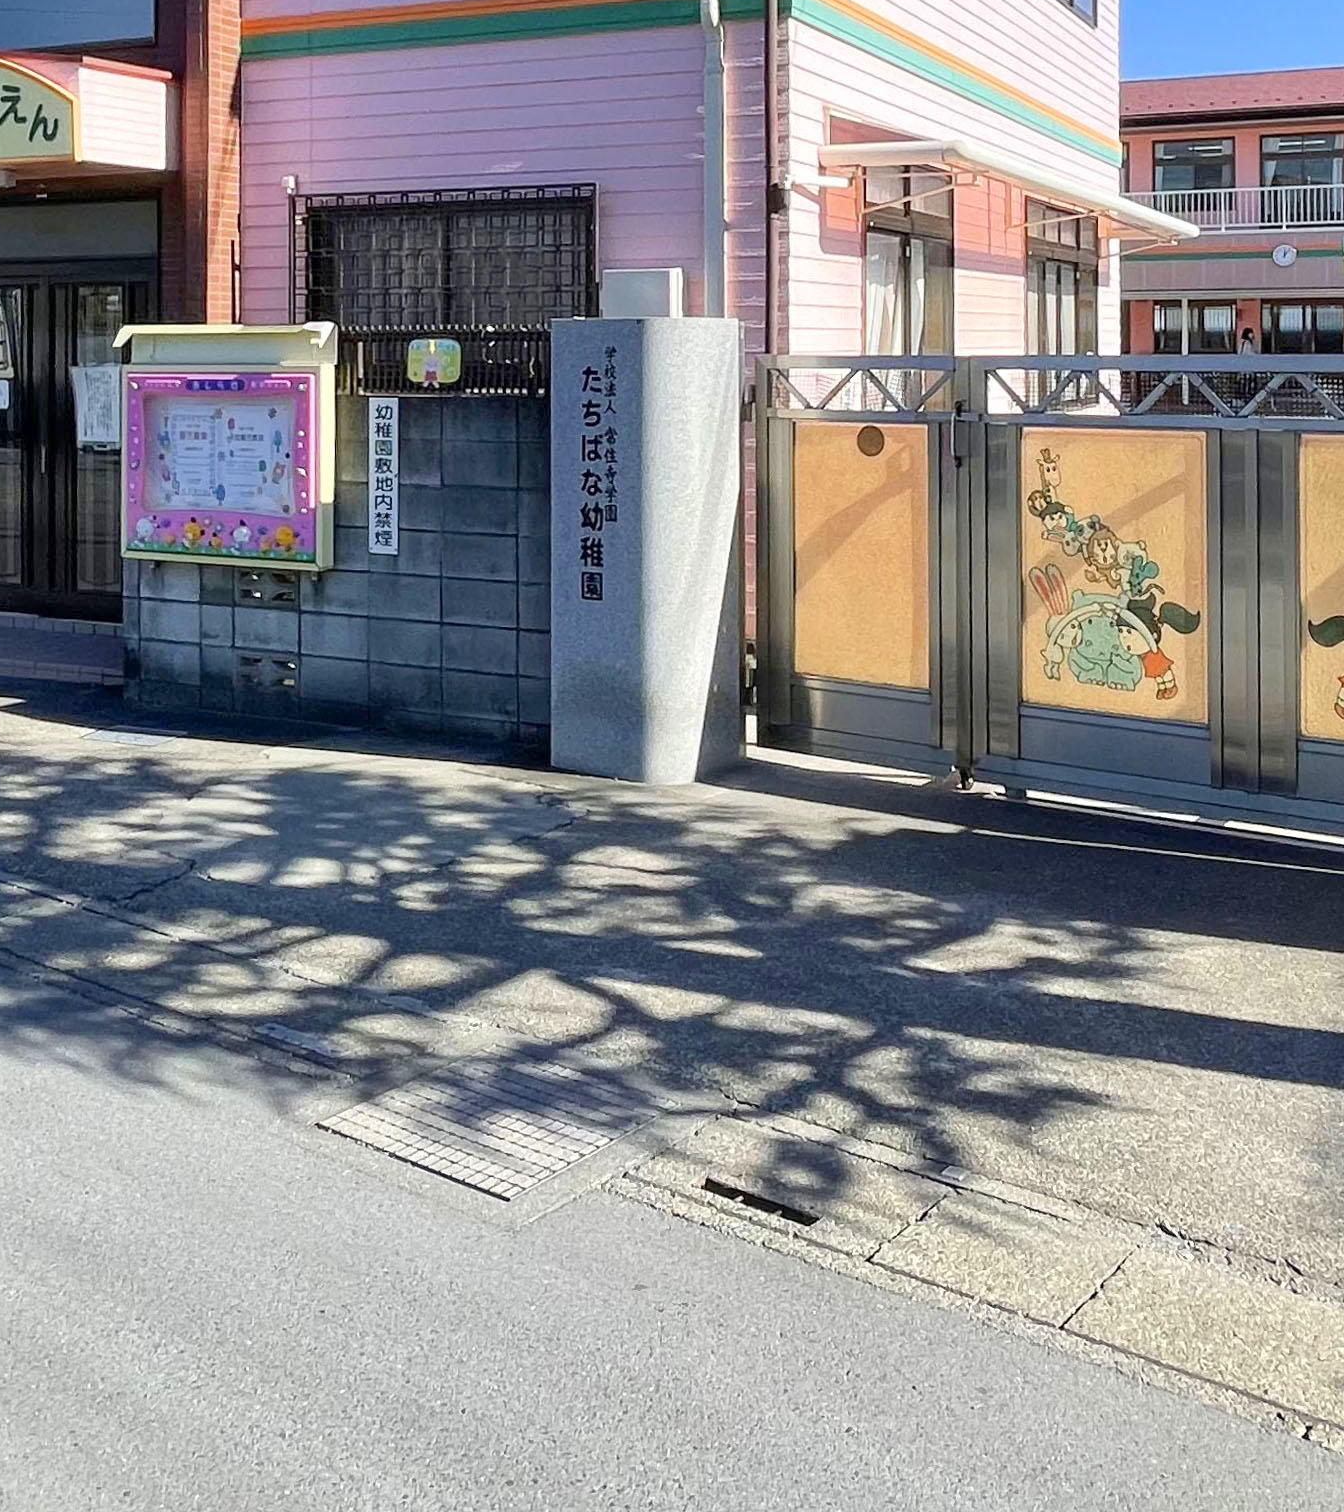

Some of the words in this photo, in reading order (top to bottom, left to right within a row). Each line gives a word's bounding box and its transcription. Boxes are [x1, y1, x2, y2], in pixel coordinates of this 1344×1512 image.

[374, 403, 394, 548] 幼稚園敷地内禁煙
[579, 365, 605, 602] たちばな幼稚園
